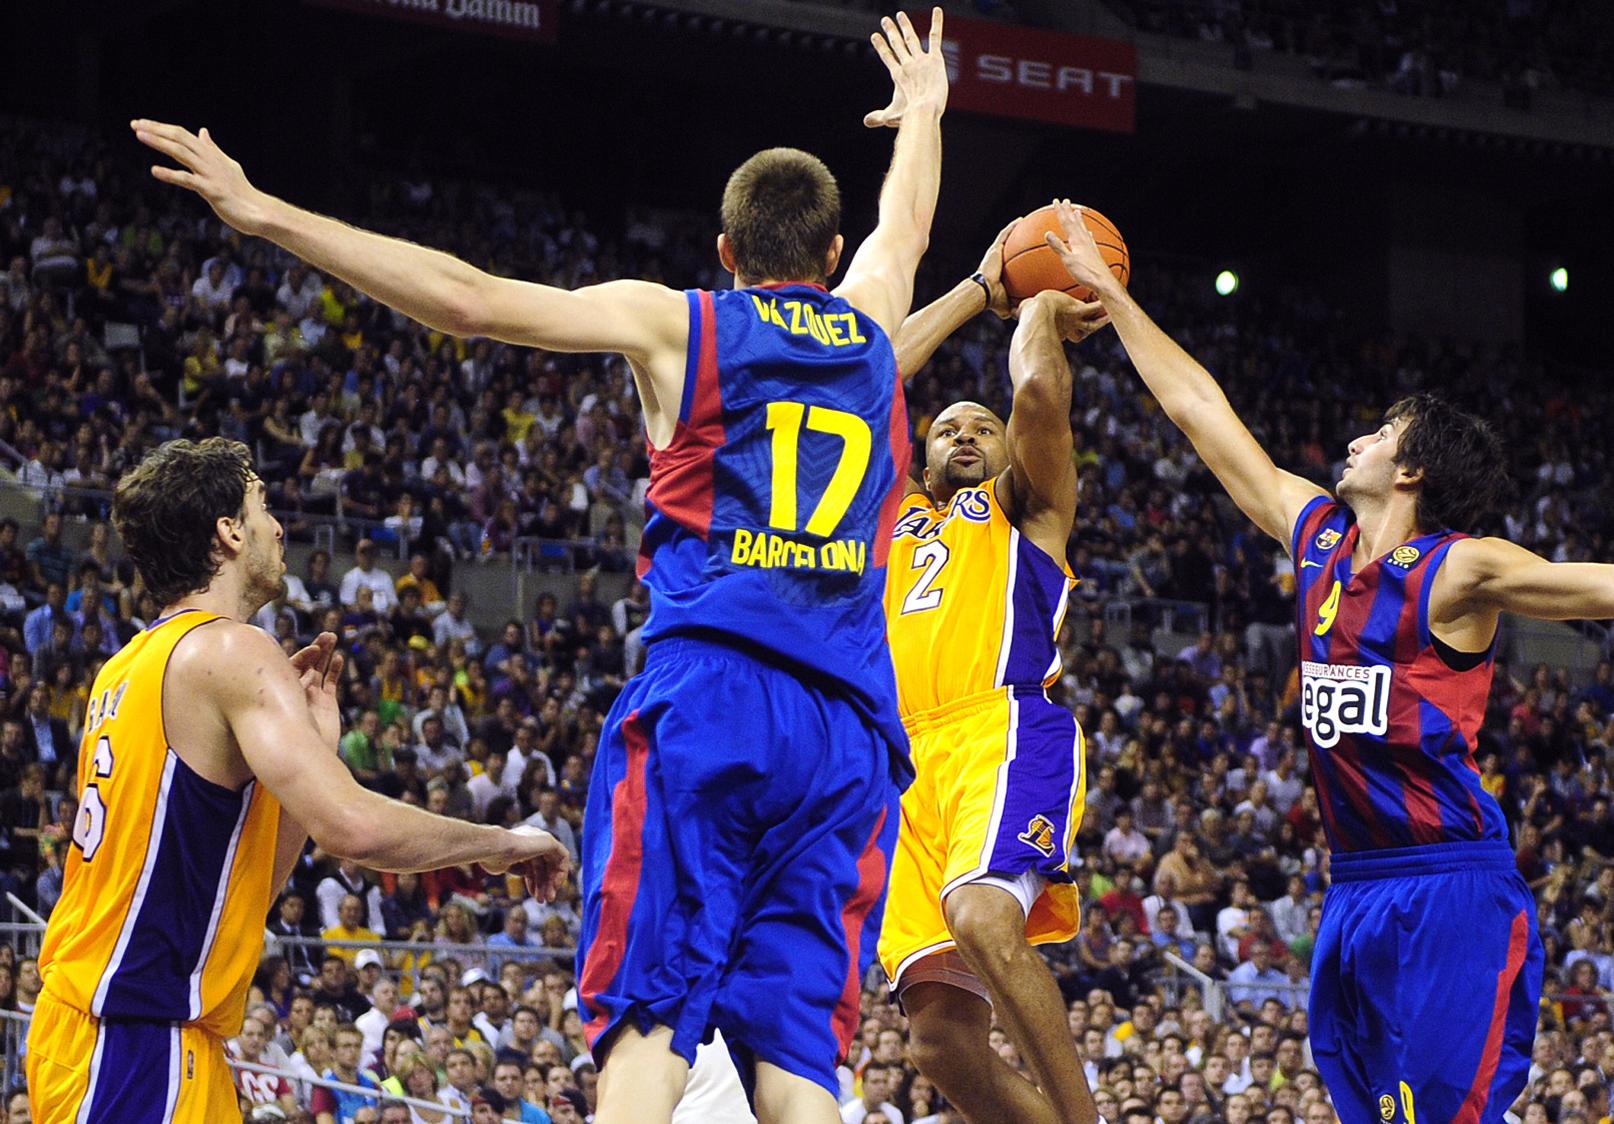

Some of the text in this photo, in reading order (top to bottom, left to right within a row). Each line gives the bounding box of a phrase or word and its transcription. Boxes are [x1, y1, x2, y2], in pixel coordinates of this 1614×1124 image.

[977, 54, 1134, 98] SEAT
[766, 401, 872, 537] 17
[901, 539, 949, 615] 2
[1314, 580, 1341, 635] 9
